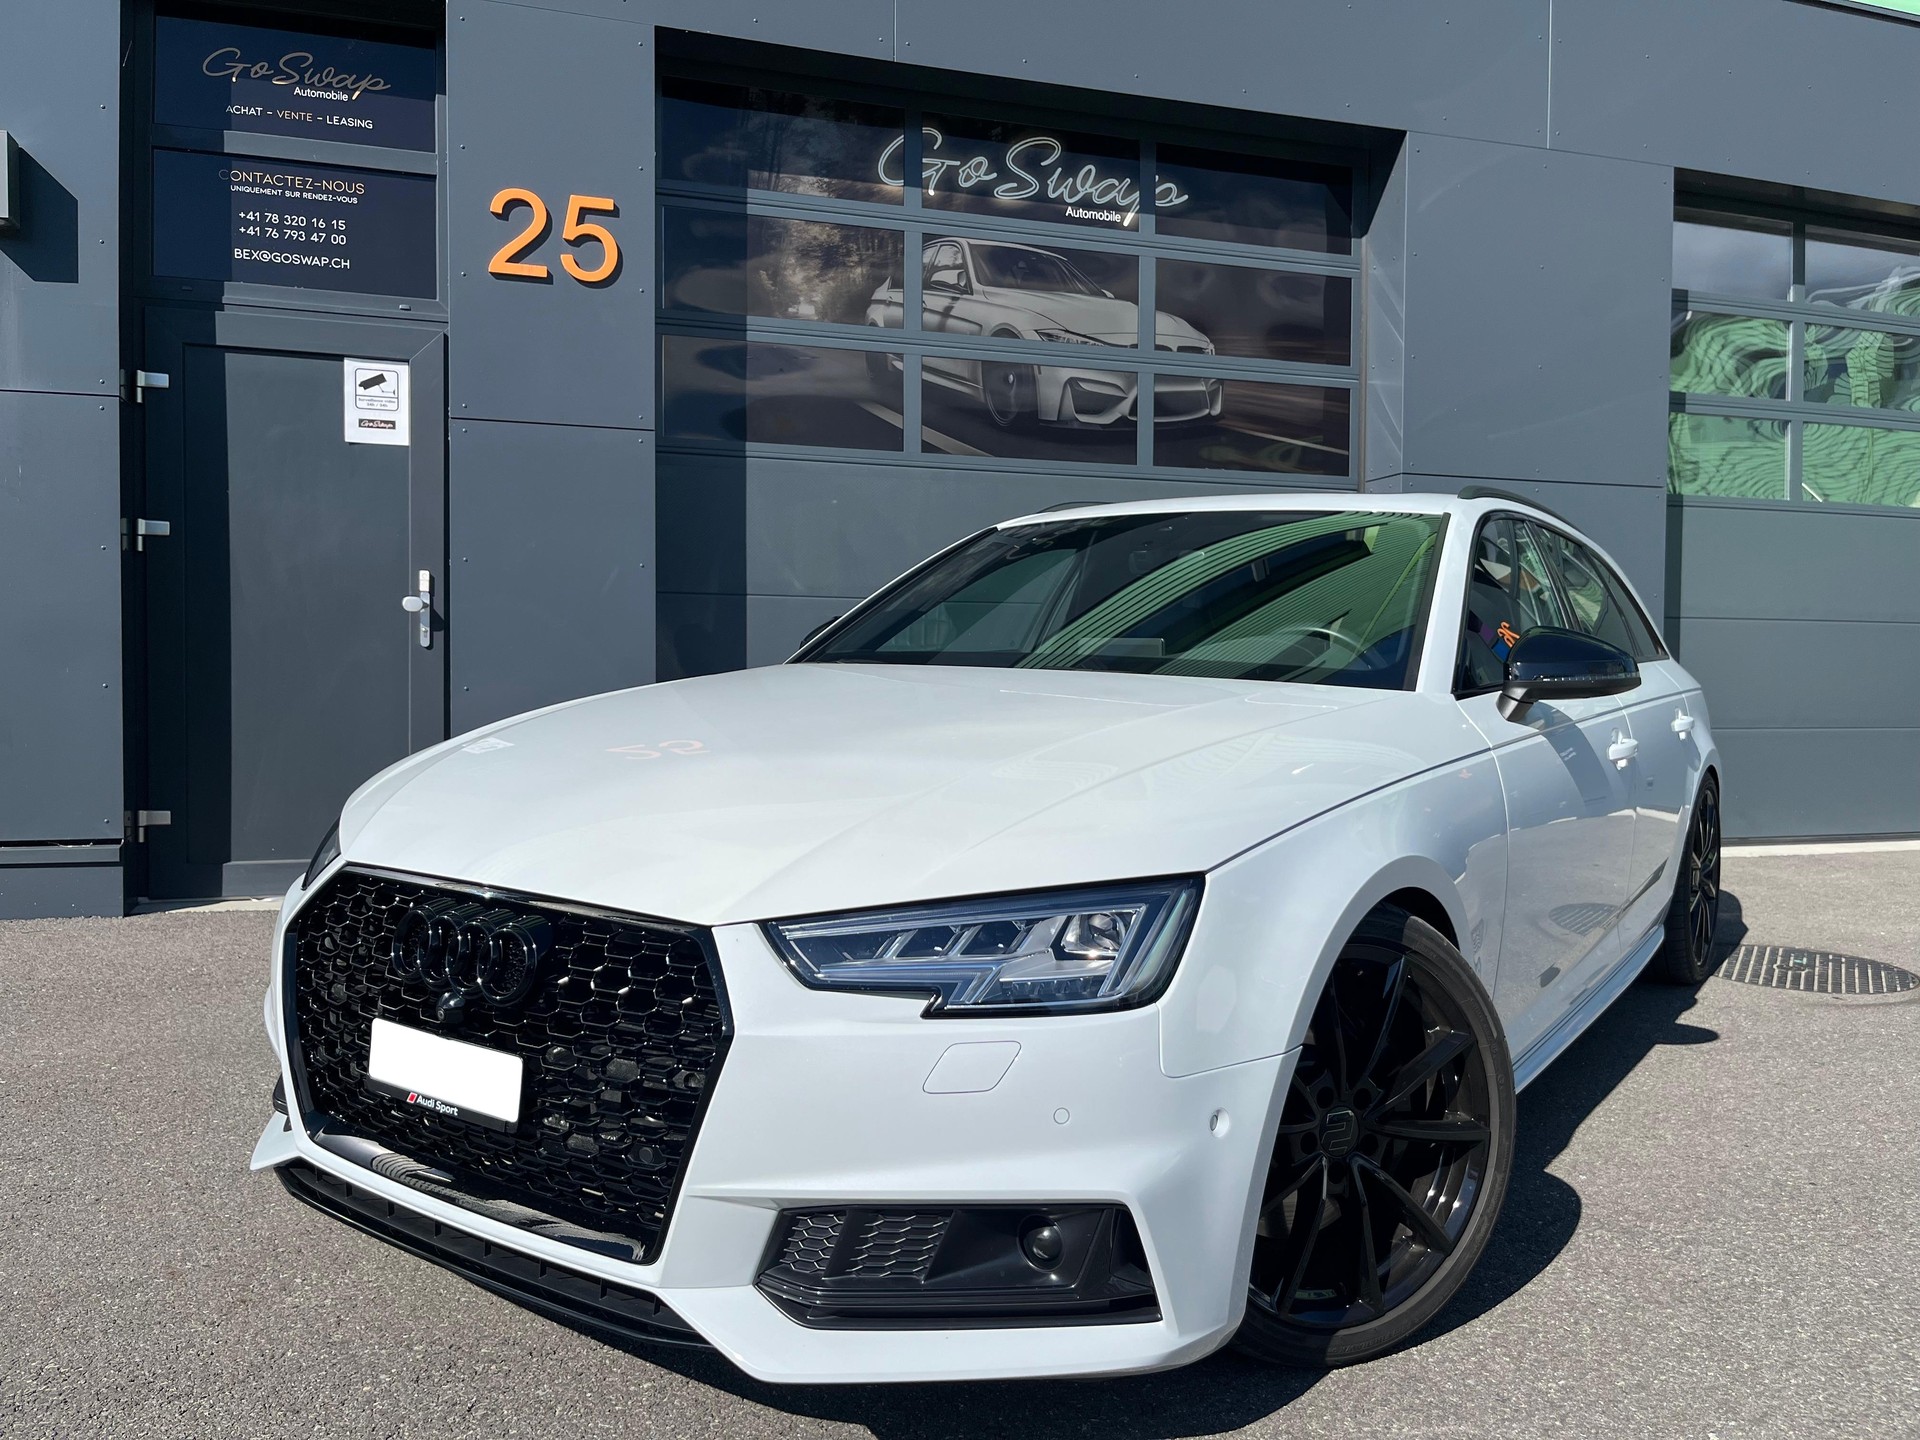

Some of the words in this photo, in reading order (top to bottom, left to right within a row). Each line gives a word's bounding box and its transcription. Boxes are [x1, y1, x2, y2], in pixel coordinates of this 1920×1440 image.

[293, 86, 349, 102] Automobile
[225, 105, 264, 116] ACHAT
[276, 109, 313, 122] VENTE
[326, 115, 374, 129] LEASING
[218, 169, 365, 195] CONTACTEZ-NOUS
[230, 184, 283, 196] UNIQUEMENT
[285, 190, 301, 198] SUR
[302, 191, 358, 204] RENDEZ-VOUS
[238, 211, 260, 222] +41
[264, 212, 280, 224] 78
[283, 214, 307, 227] 320
[311, 217, 326, 229] 16
[331, 219, 346, 230] 15
[1065, 206, 1122, 223] Automobile
[238, 226, 260, 237] +41
[264, 227, 280, 239] 76
[283, 229, 306, 242] 793
[310, 232, 327, 243] 47
[330, 234, 347, 245] 00
[488, 187, 619, 284] 25
[234, 248, 350, 269] BEX@GOSWAP.CH
[416, 1095, 435, 1109] Audi
[435, 1100, 459, 1116] Sport
